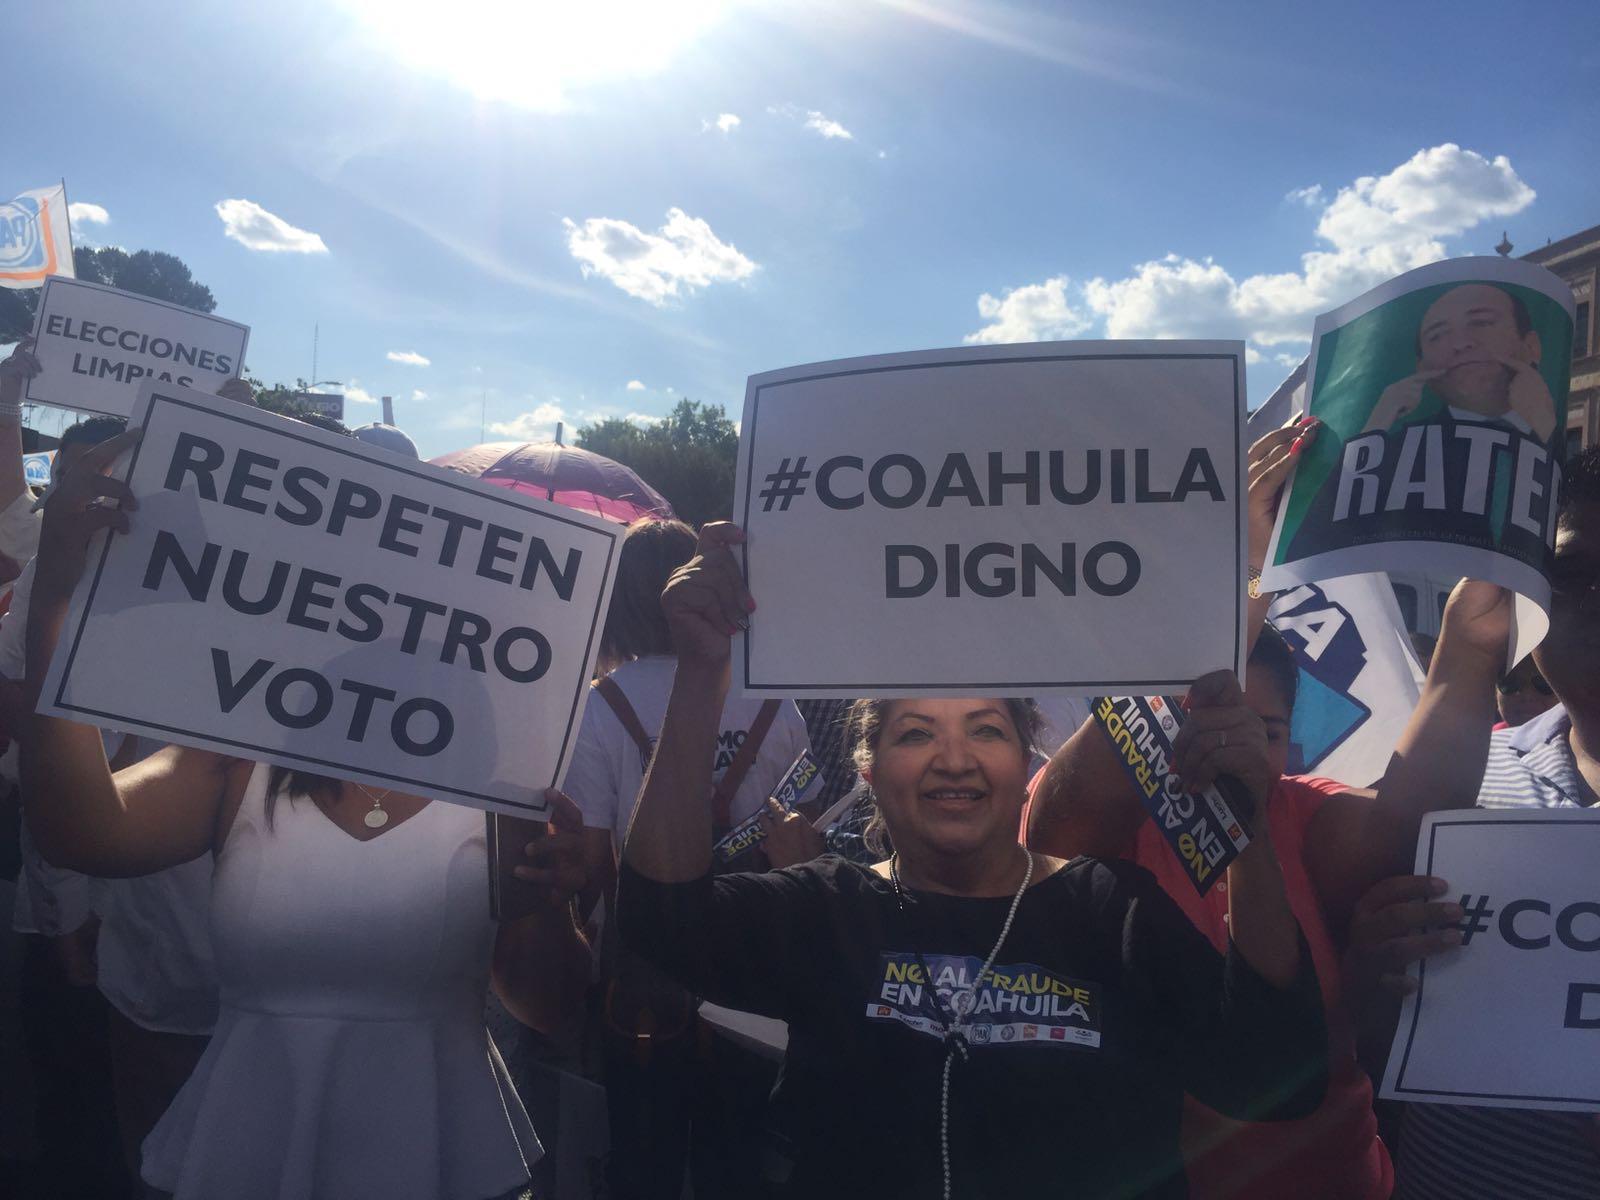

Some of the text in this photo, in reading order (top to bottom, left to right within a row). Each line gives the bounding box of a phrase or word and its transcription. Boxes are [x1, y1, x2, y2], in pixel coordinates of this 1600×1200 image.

[46, 315, 232, 375] ELECCIONES
[758, 447, 1227, 512] #COAHUILA
[165, 431, 583, 602] RESPETEN
[885, 541, 1142, 599] DIGNO
[142, 531, 553, 684] NUESTRO
[210, 647, 456, 758] VOTO
[1097, 696, 1159, 799] FRAUDE
[1157, 791, 1183, 830] AL
[1191, 817, 1226, 868] EN
[880, 983, 923, 1007] EN
[935, 966, 972, 989] AL
